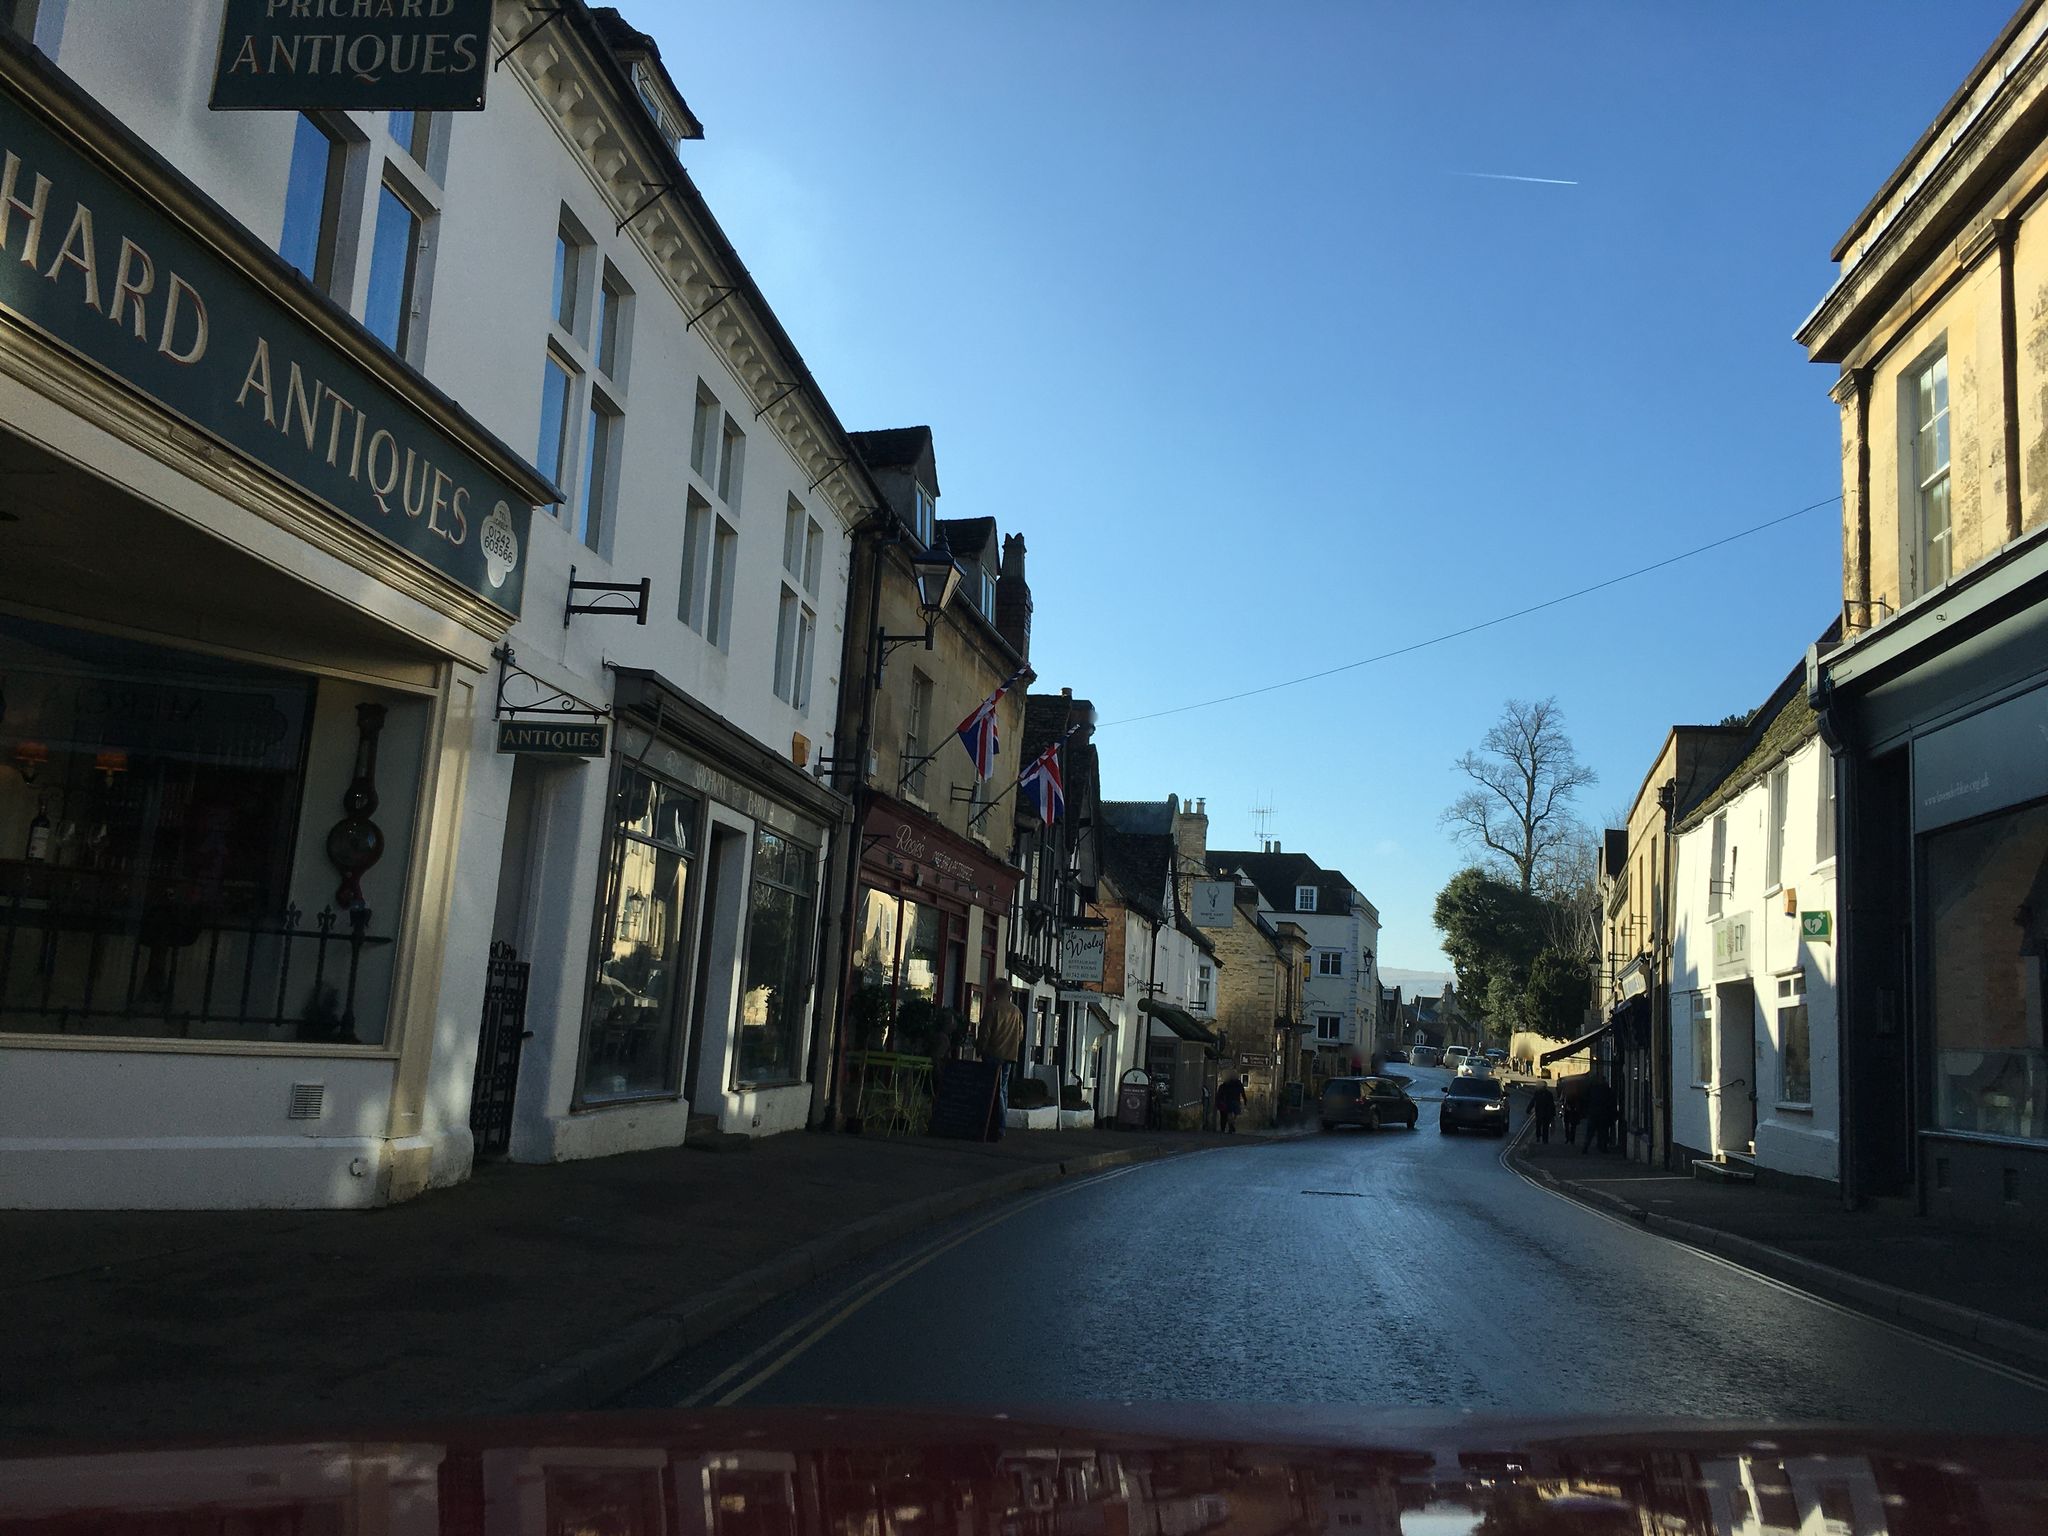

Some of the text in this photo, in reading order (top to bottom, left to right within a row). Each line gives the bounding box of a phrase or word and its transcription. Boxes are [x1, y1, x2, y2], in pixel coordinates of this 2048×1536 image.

[265, 0, 453, 18] PRICHARD
[227, 34, 478, 83] ANTIQUES
[235, 336, 471, 545] ANTIQUES
[484, 536, 513, 563] 603566
[488, 525, 511, 550] 01242
[503, 729, 600, 749] ANTIQUES
[1065, 934, 1104, 958] Wesley
